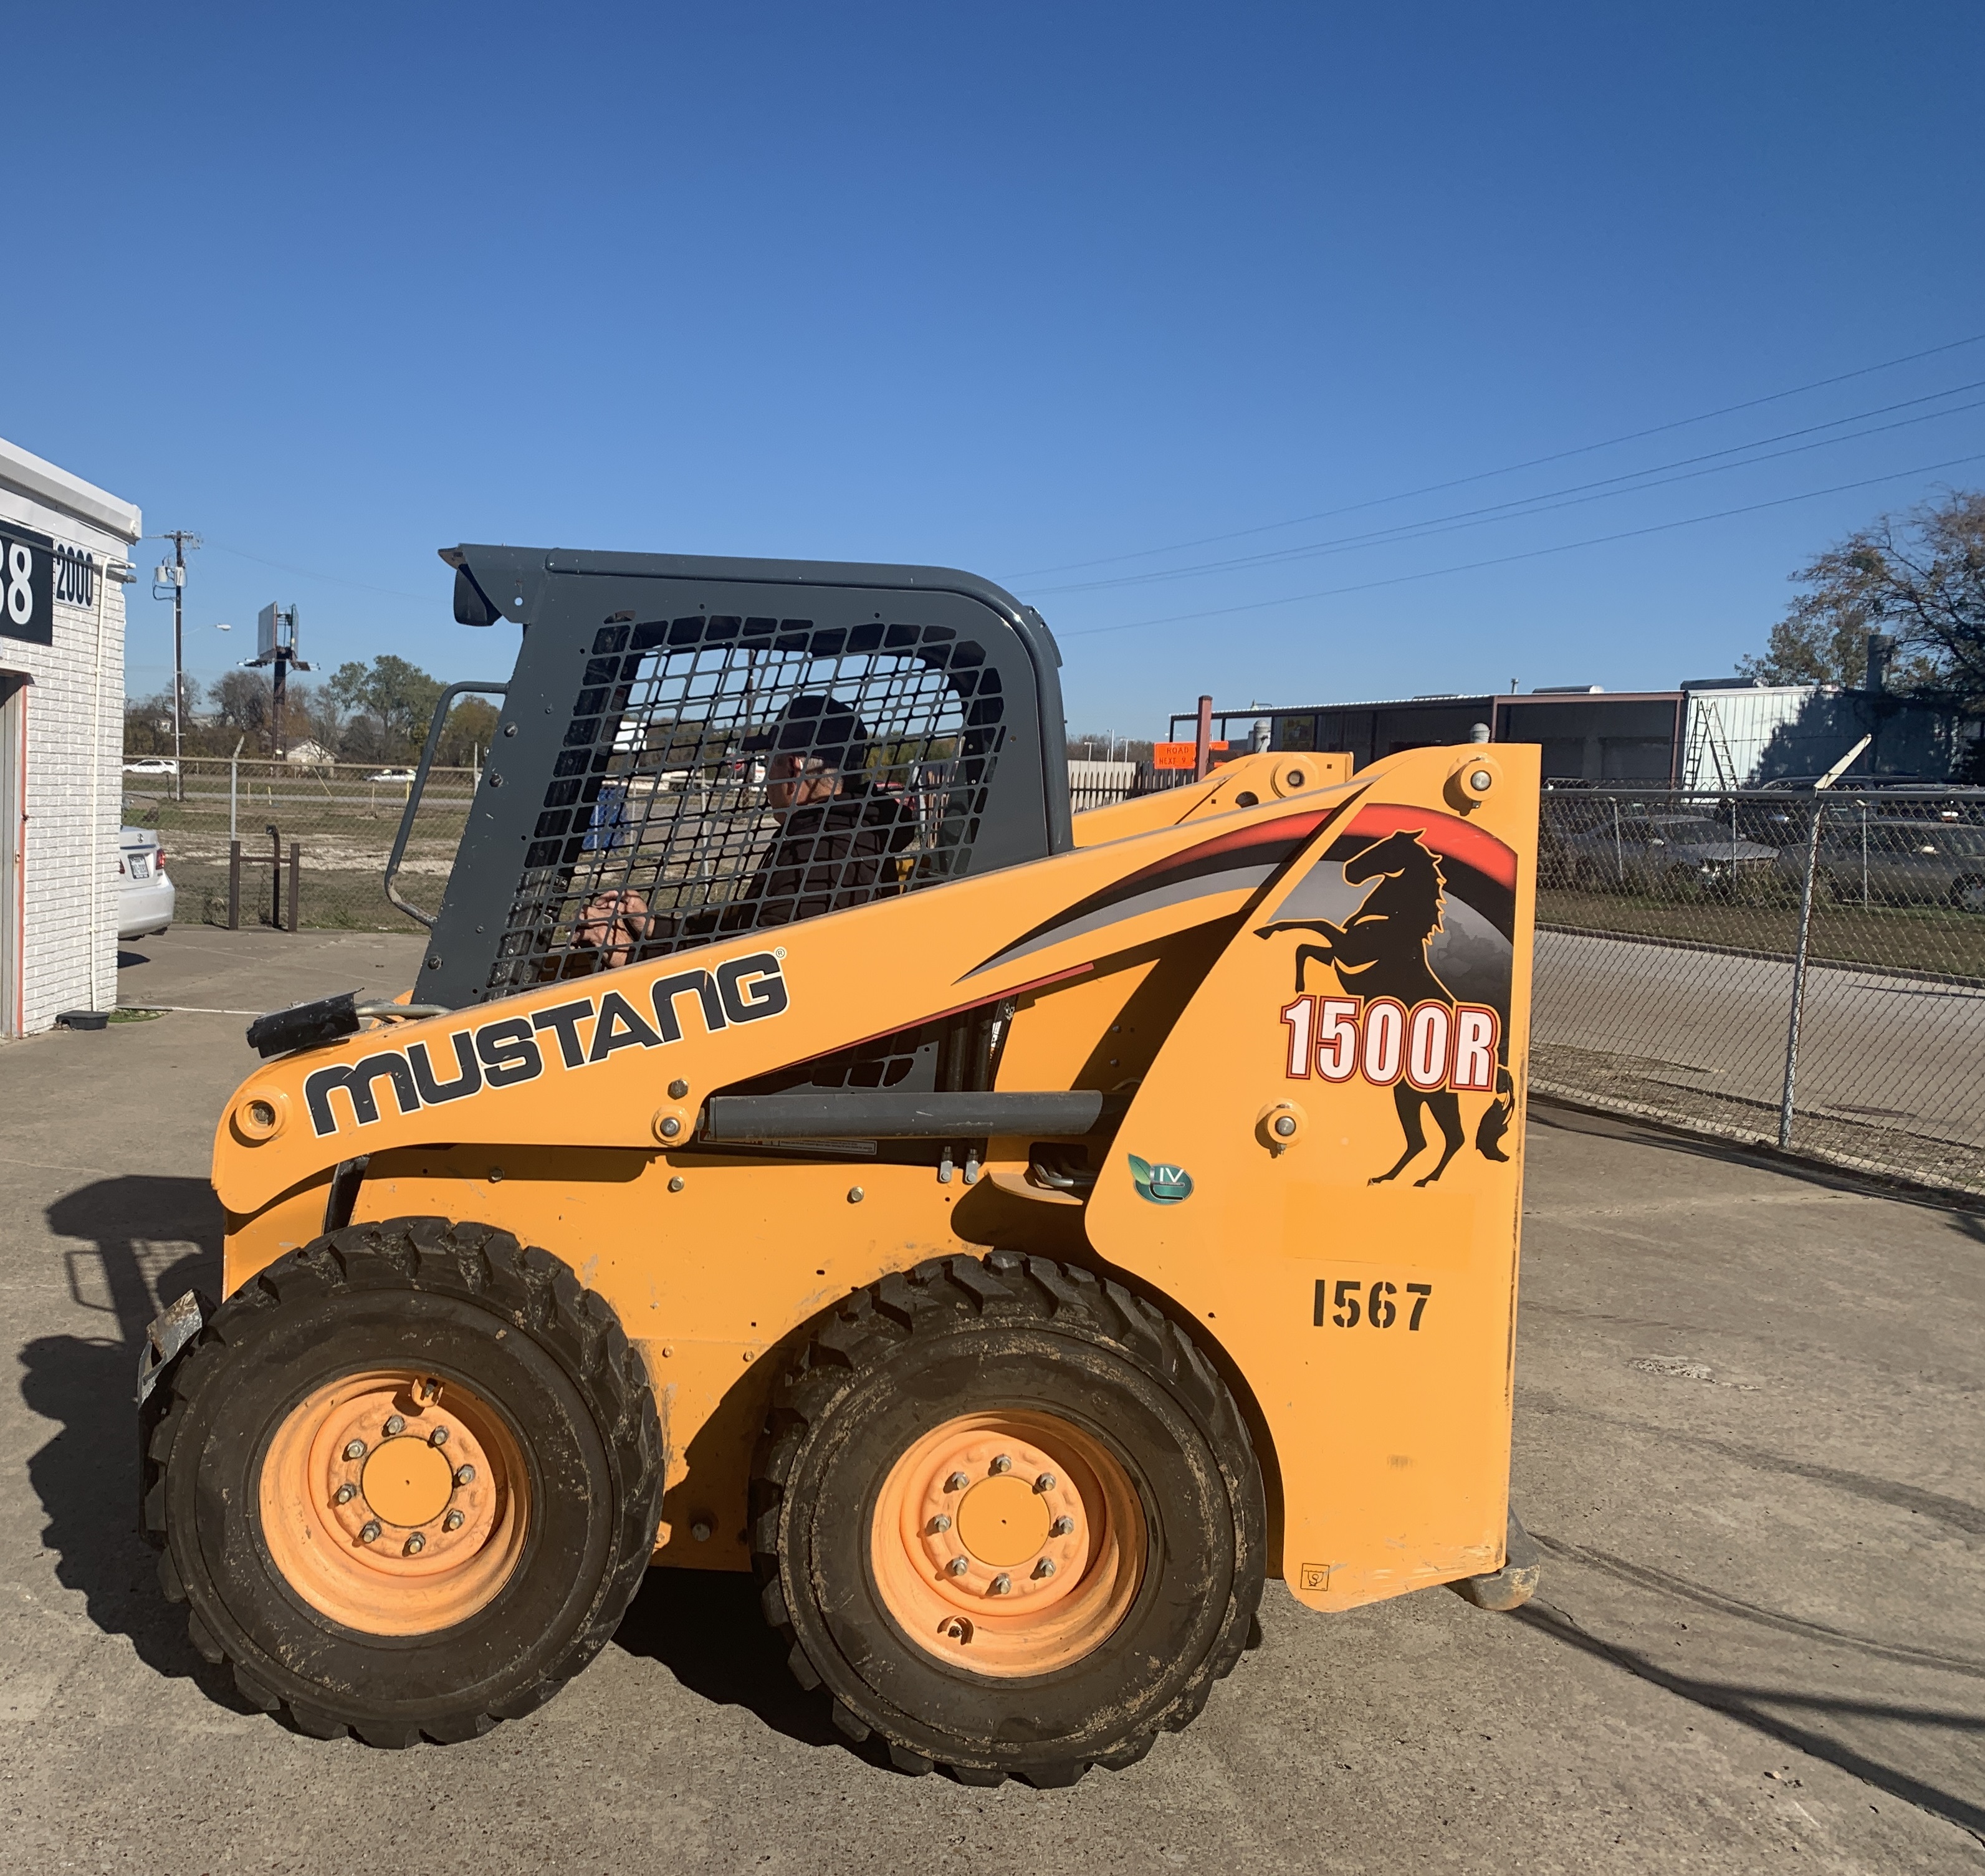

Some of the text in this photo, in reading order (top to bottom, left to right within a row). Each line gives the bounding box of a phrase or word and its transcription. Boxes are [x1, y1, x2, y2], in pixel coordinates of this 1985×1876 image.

[56, 543, 93, 606] 2000
[1159, 757, 1177, 765] NEXT
[1280, 994, 1496, 1092] 1500R
[1160, 1167, 1184, 1182] IV
[1313, 1279, 1432, 1331] 1567
